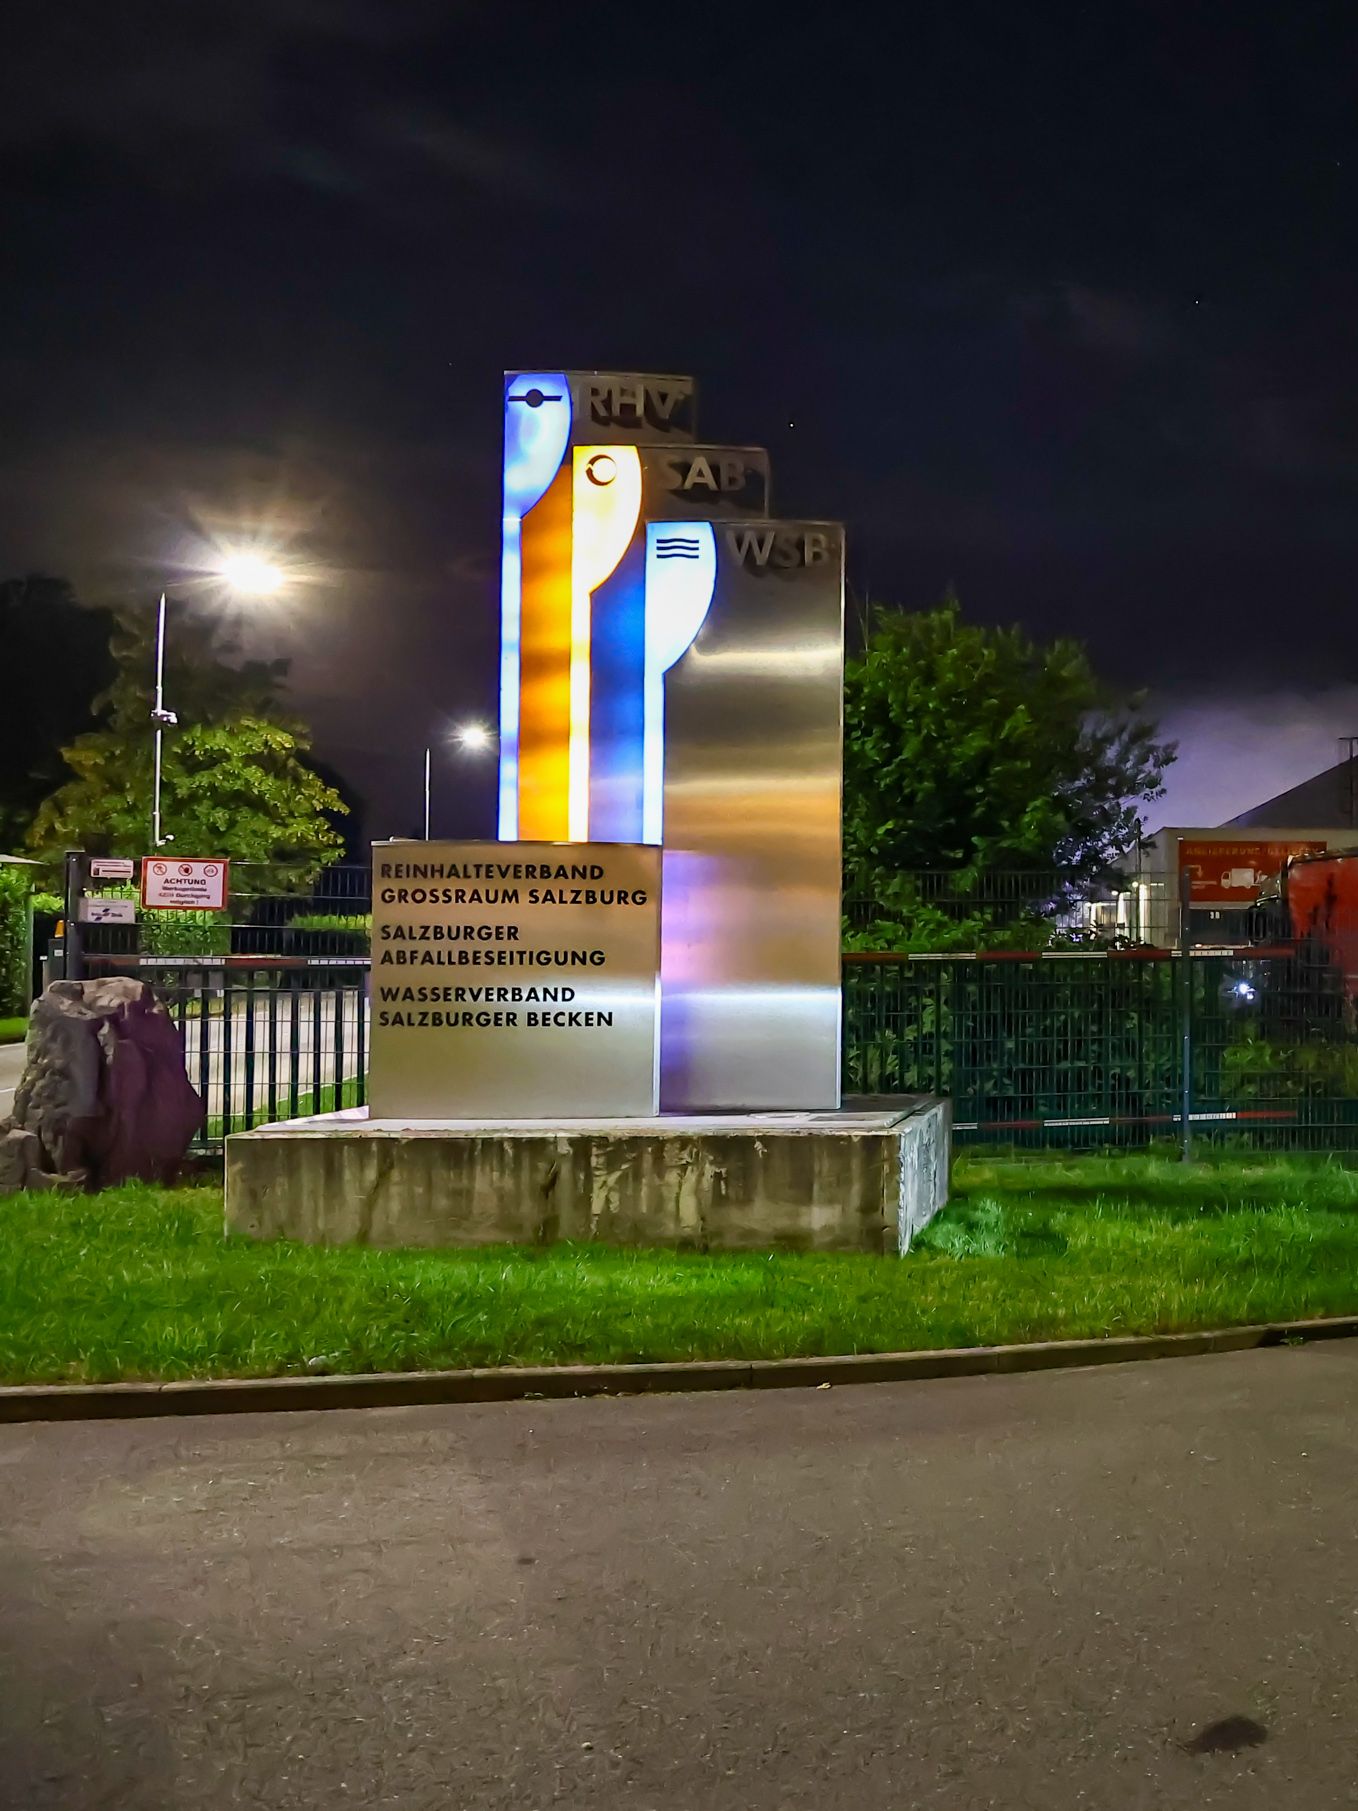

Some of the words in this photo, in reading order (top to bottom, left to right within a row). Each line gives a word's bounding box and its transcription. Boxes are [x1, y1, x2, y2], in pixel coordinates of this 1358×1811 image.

[583, 384, 684, 419] RHV
[659, 456, 747, 491] SAB
[726, 530, 833, 567] WSB
[380, 863, 605, 880] REINHALTEVERBAND
[380, 888, 520, 905] GROSSRAUM
[528, 888, 648, 906] SALZBURG
[380, 925, 520, 941] SALZBURGER
[380, 950, 606, 966] ABFALLBESEITIGUNG
[380, 986, 576, 1002] WASSERVERBAND
[379, 1011, 519, 1027] SALZBURGER
[526, 1011, 614, 1027] BECKEN
